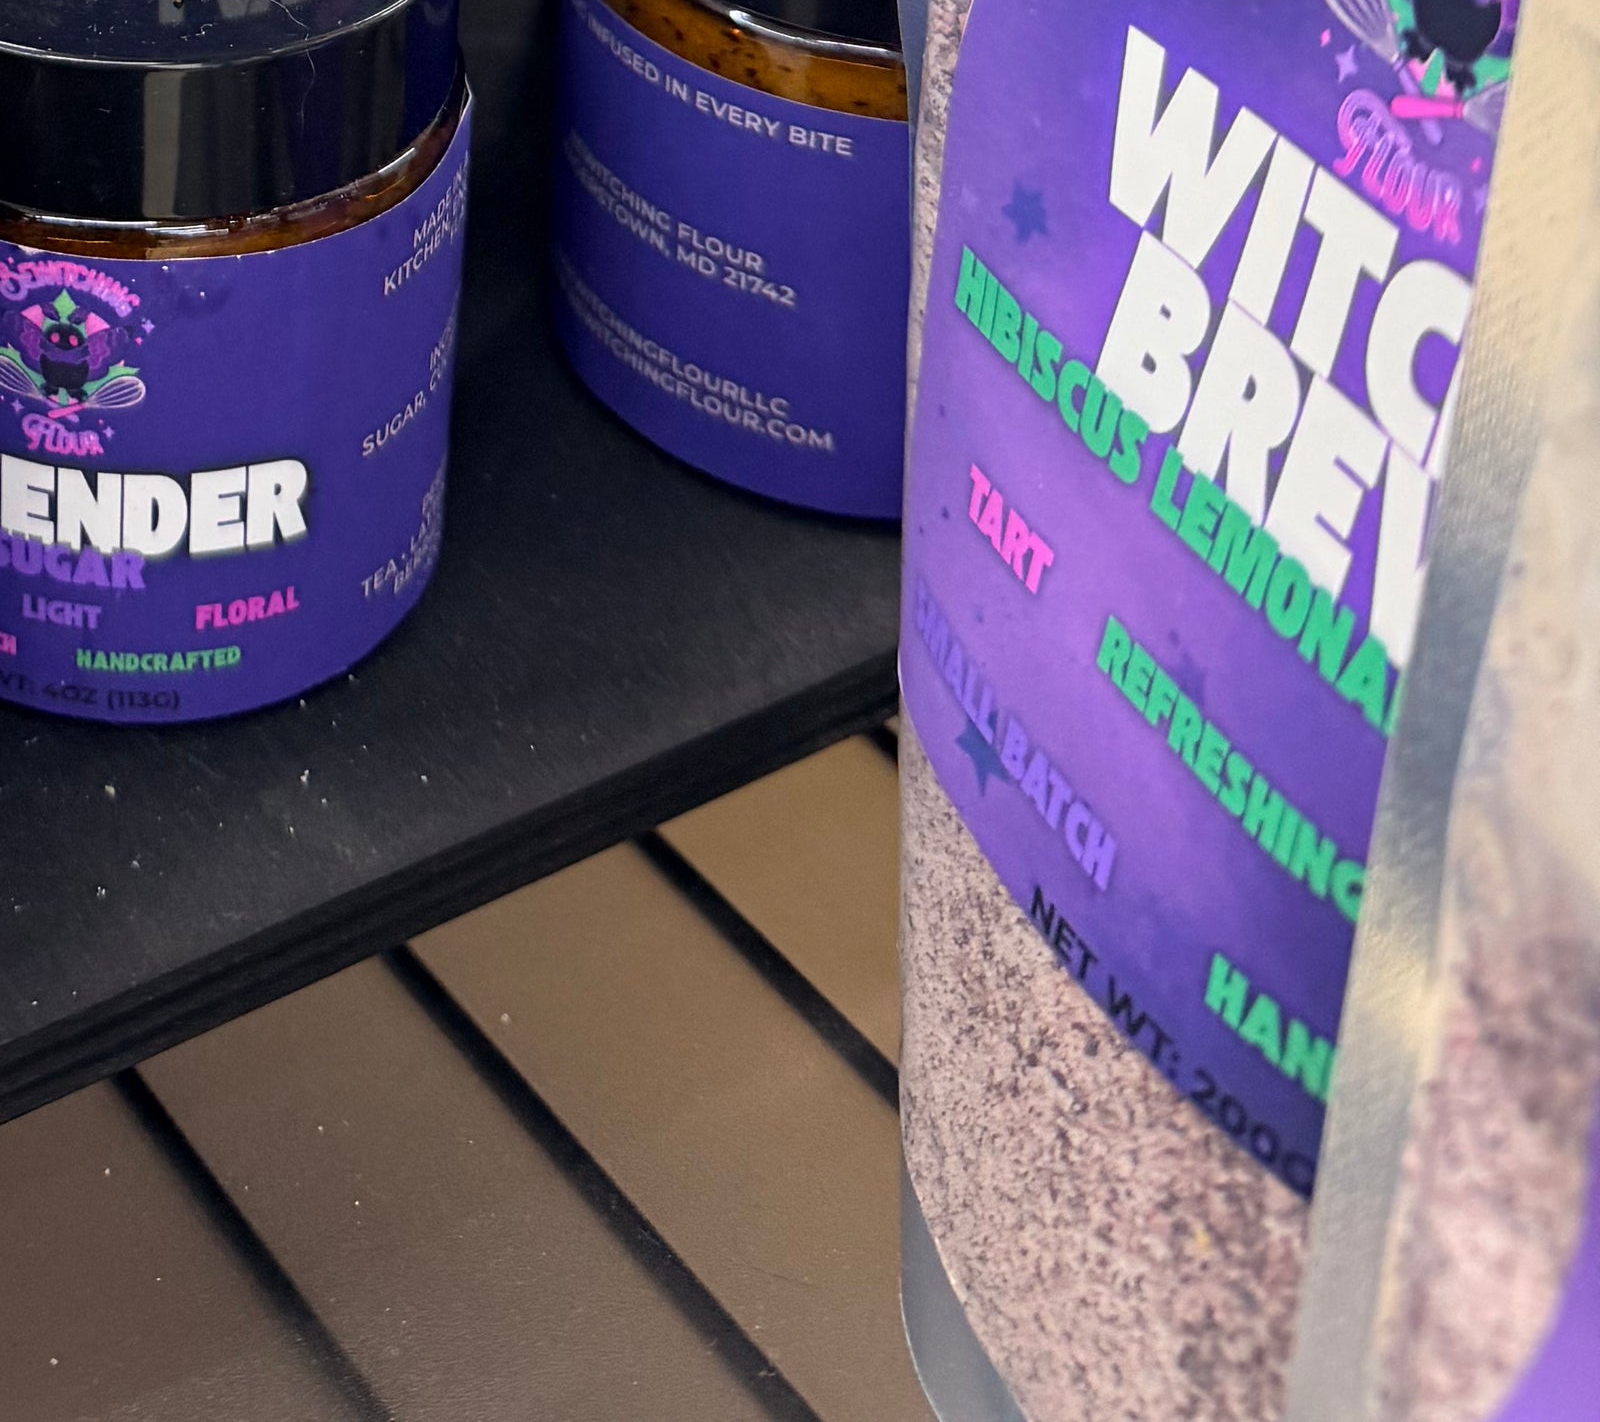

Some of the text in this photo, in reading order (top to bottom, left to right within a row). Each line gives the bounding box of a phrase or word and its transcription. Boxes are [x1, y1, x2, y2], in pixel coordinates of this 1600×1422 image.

[665, 74, 688, 102] IN
[695, 90, 782, 140] EVERY
[788, 125, 855, 156] BITE
[675, 244, 798, 307] MD 21742
[676, 222, 764, 273] FLOUR
[1108, 23, 1475, 477] WITC
[954, 243, 1403, 739] HIBISCUS LEMONA
[970, 462, 1054, 596] TART
[22, 593, 102, 630] LIGHT
[195, 586, 300, 631] FLORAL
[76, 644, 242, 674] HANDCRAFTED
[1000, 714, 1118, 894] BATCH
[1096, 613, 1367, 925] REFRESHING
[1030, 883, 1099, 980] NET
[1203, 951, 1337, 1105] HAN
